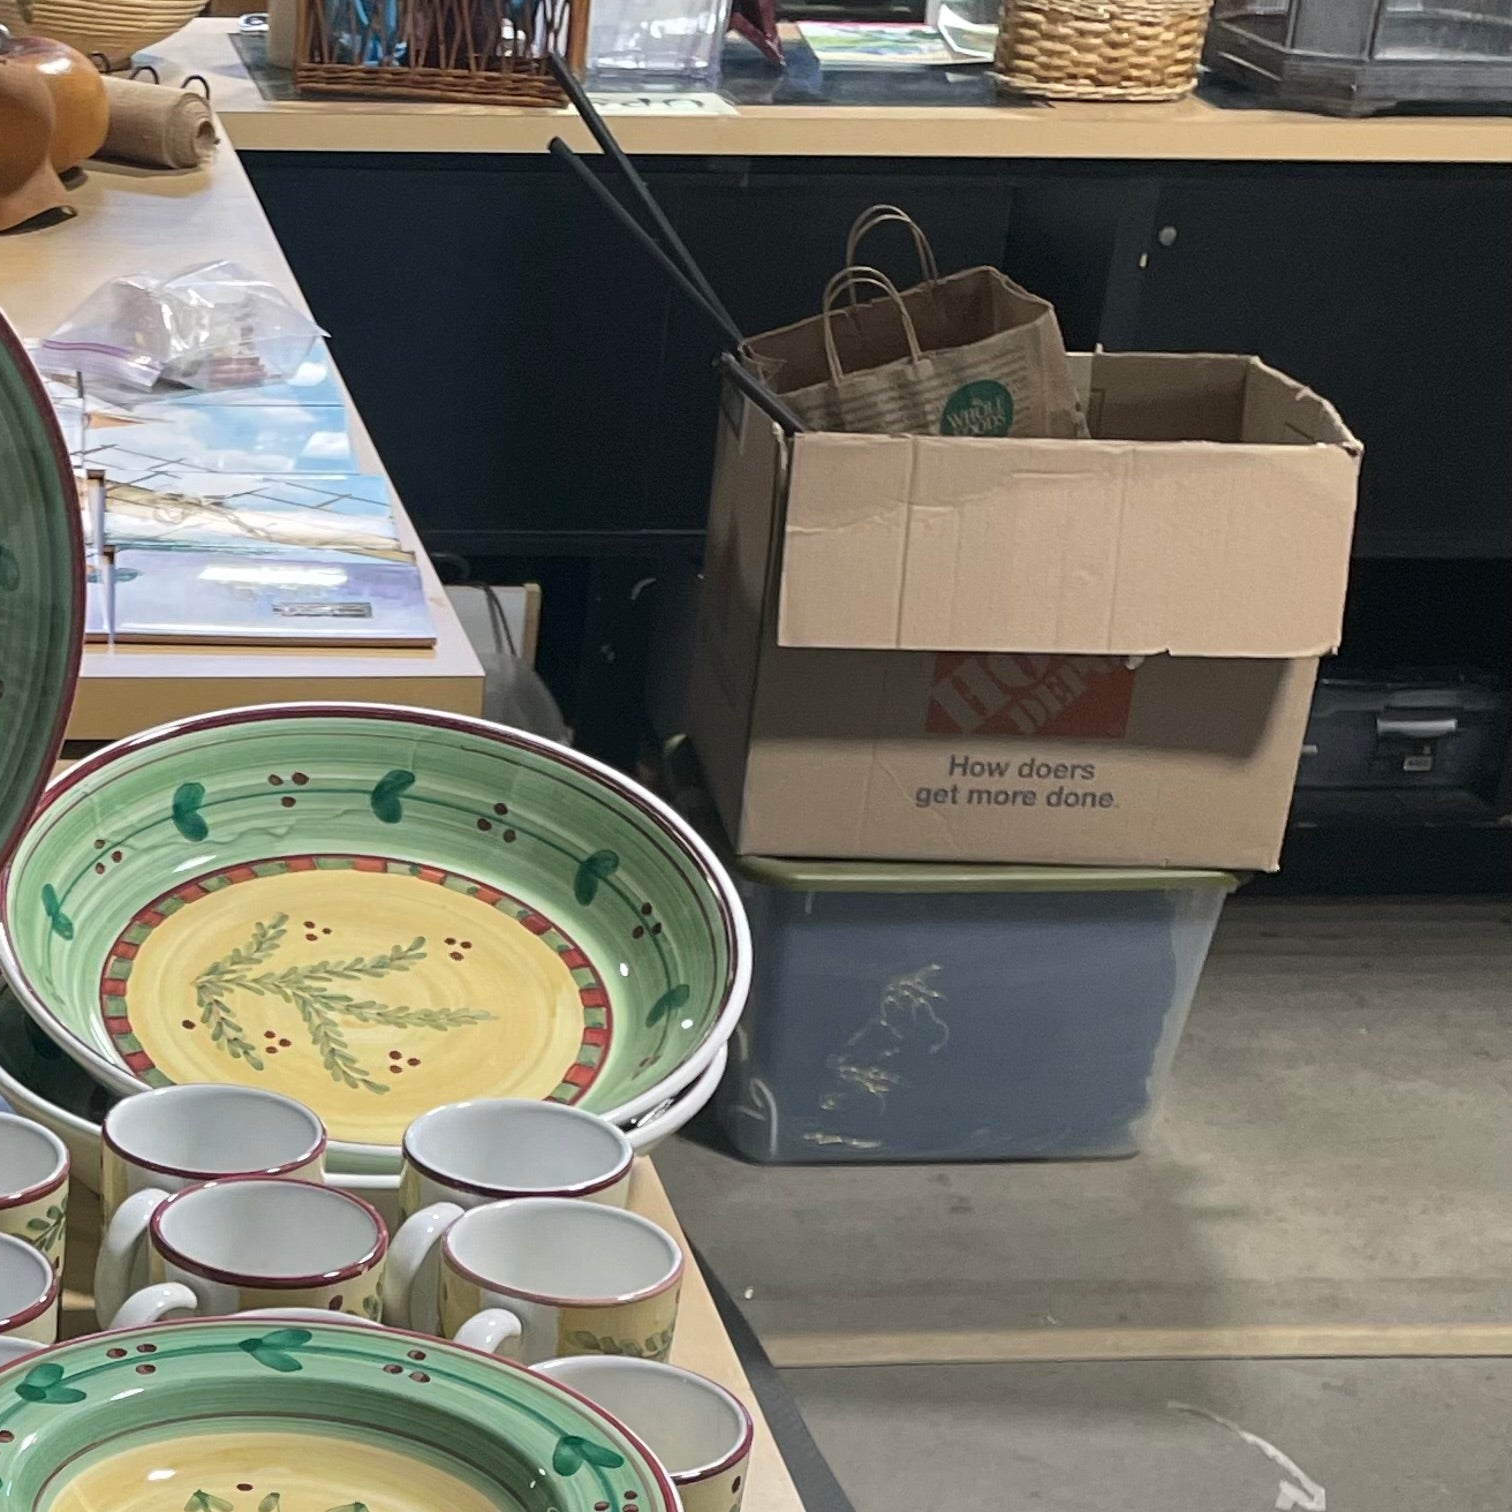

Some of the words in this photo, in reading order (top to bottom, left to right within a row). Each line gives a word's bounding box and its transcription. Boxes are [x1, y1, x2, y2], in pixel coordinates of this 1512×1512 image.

[948, 754, 1010, 778] How
[1017, 757, 1096, 781] doers
[915, 783, 960, 809] get
[966, 787, 1037, 807] more
[1046, 785, 1121, 809] done.
